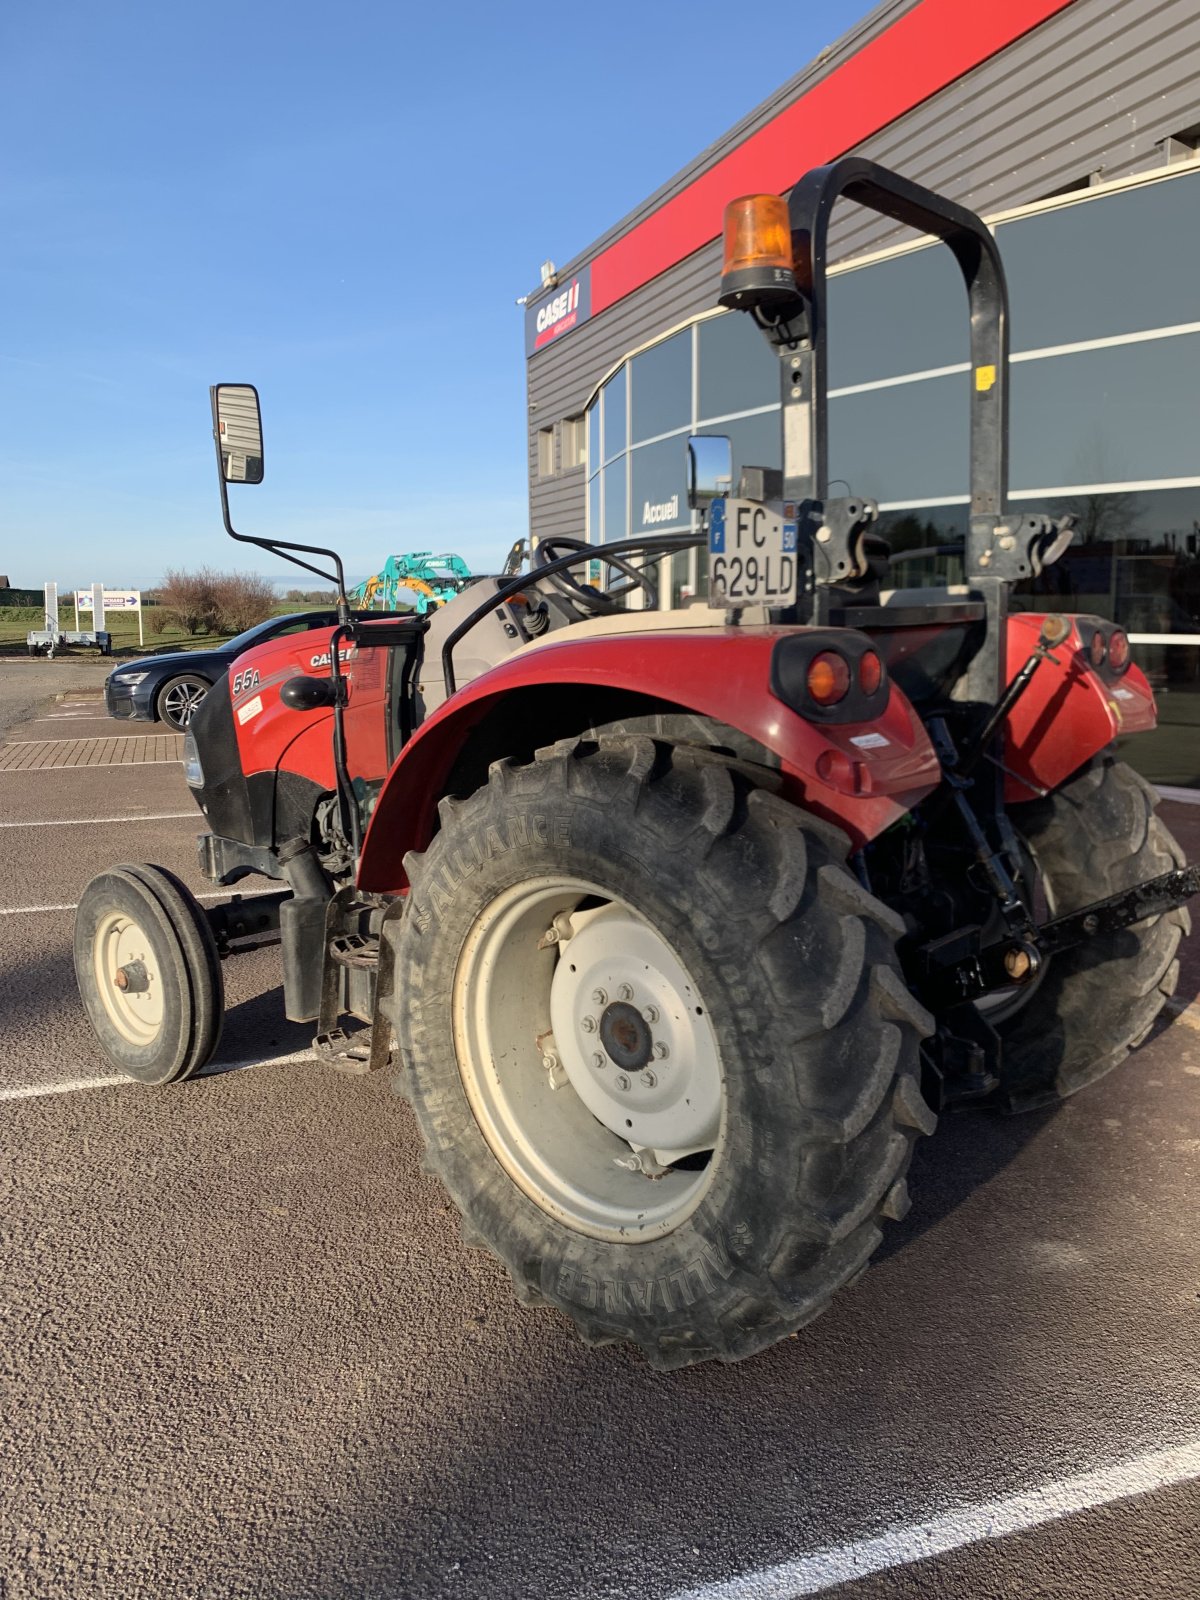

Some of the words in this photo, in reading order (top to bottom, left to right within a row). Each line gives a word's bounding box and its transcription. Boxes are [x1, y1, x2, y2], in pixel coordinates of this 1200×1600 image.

[537, 291, 568, 333] CASE
[642, 494, 679, 525] Accueil
[715, 532, 720, 544] F
[784, 532, 794, 549] 50
[233, 668, 260, 695] 55A
[427, 814, 576, 922] ALLIANCE
[556, 1224, 735, 1316] ALLIANCE
